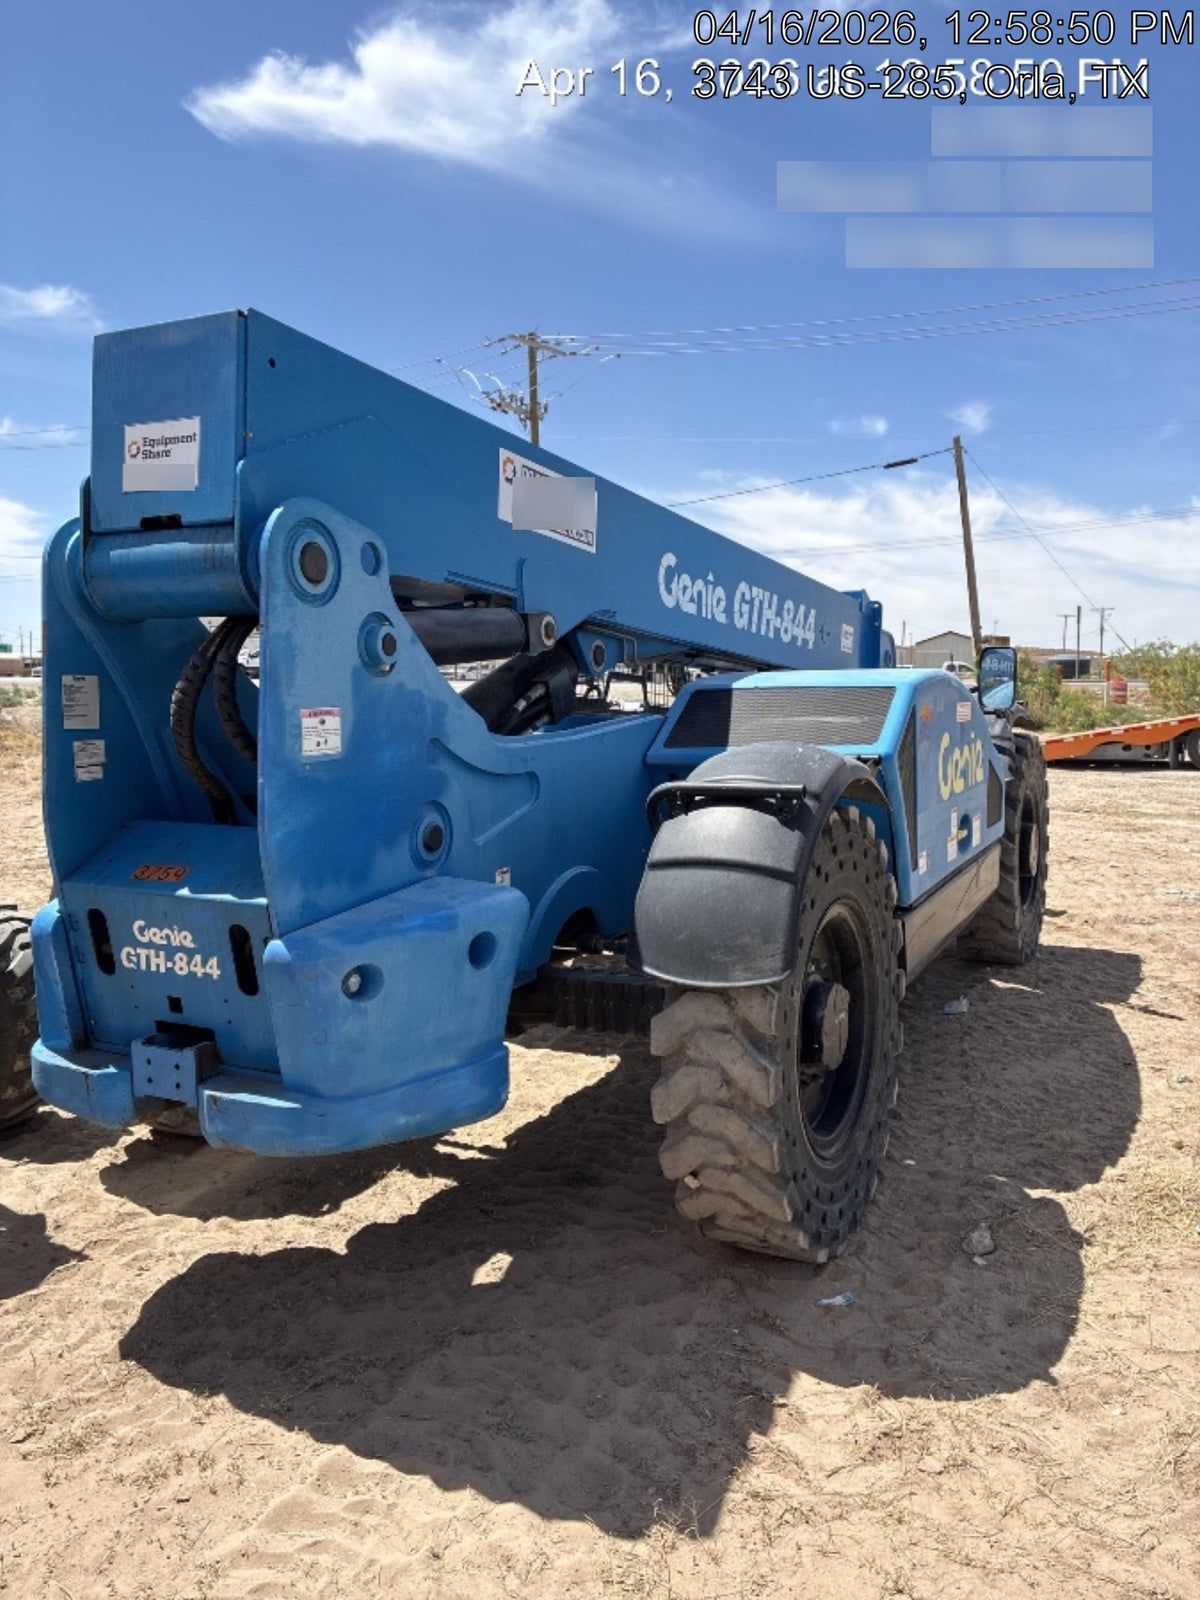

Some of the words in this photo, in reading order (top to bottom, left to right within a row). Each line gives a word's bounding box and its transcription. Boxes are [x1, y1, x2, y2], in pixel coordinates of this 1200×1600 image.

[142, 432, 197, 448] Equipment
[142, 449, 172, 460] Share
[658, 552, 728, 625] Genie
[733, 580, 817, 650] GTH-844
[132, 919, 198, 948] Genie
[120, 946, 221, 980] GTH-844
